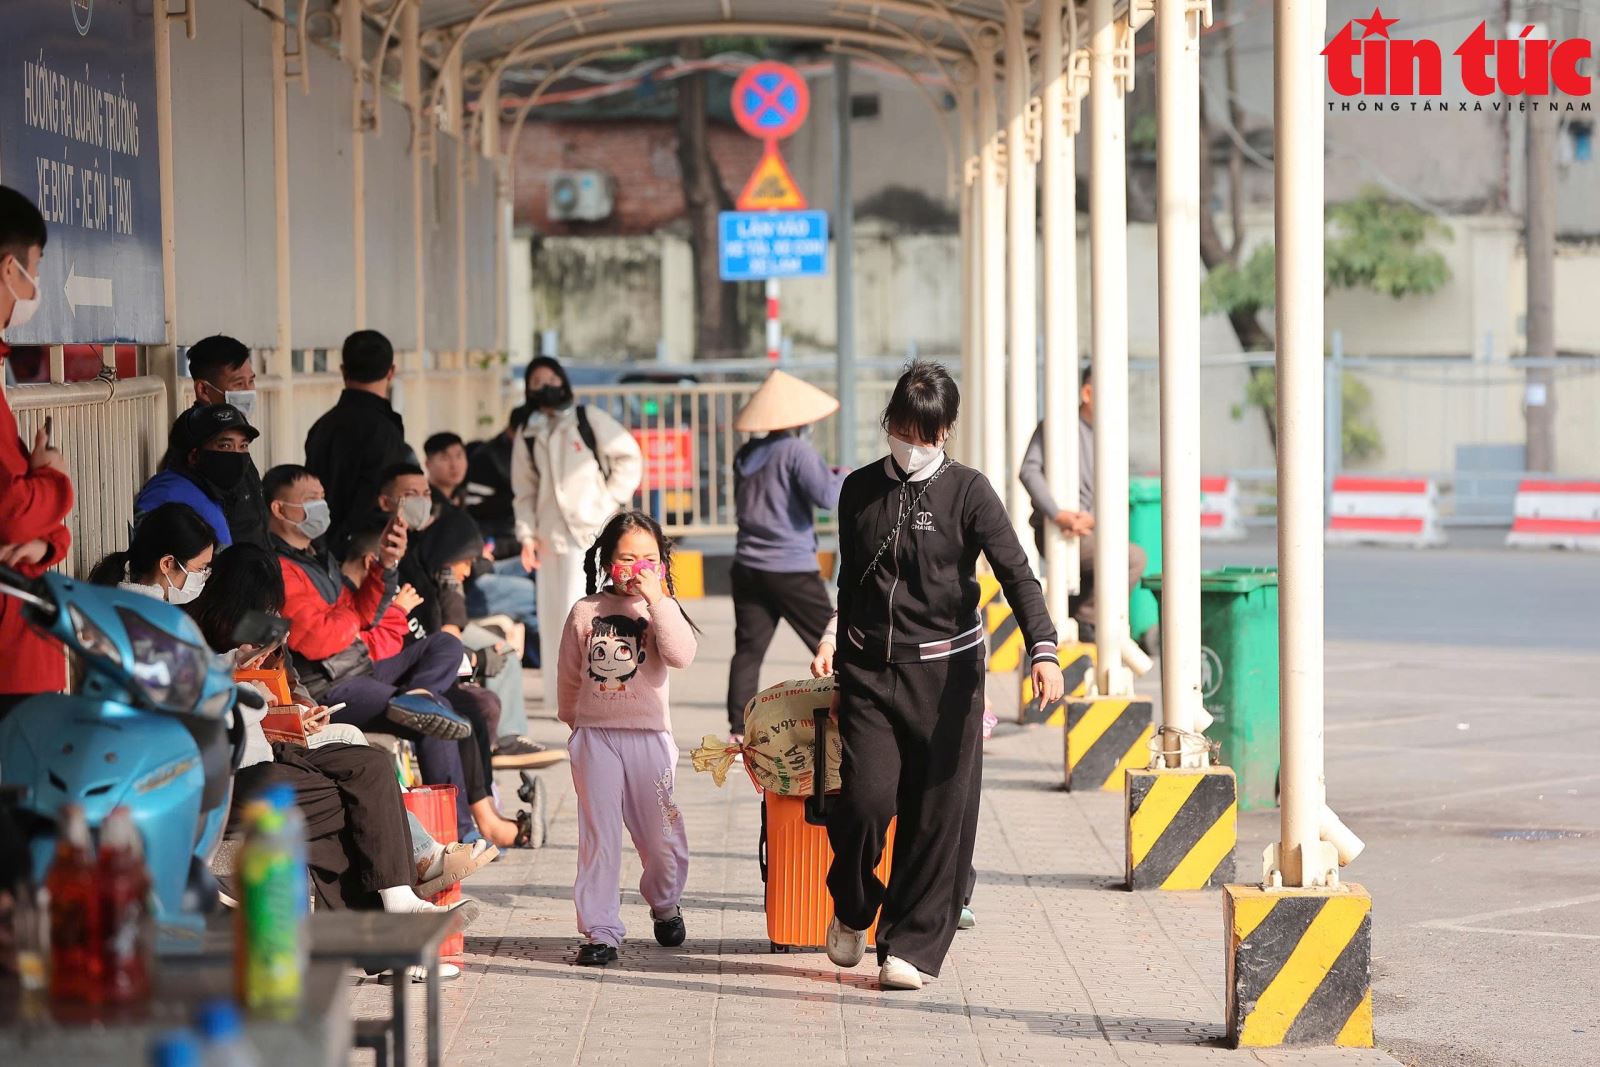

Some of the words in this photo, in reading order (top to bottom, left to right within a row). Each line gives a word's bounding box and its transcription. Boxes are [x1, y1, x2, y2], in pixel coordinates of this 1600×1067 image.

[24, 48, 59, 134] HƯỚNG
[60, 74, 73, 139] RA
[73, 62, 103, 147] QUẢNG
[103, 72, 139, 158] TRƯỜNG
[36, 156, 50, 221] XE
[51, 146, 74, 225] BUÝT
[80, 168, 93, 229] XE
[94, 157, 107, 231] ÔM
[113, 176, 133, 235] TAXI
[911, 524, 937, 532] CHANEL
[770, 718, 797, 735] 46A
